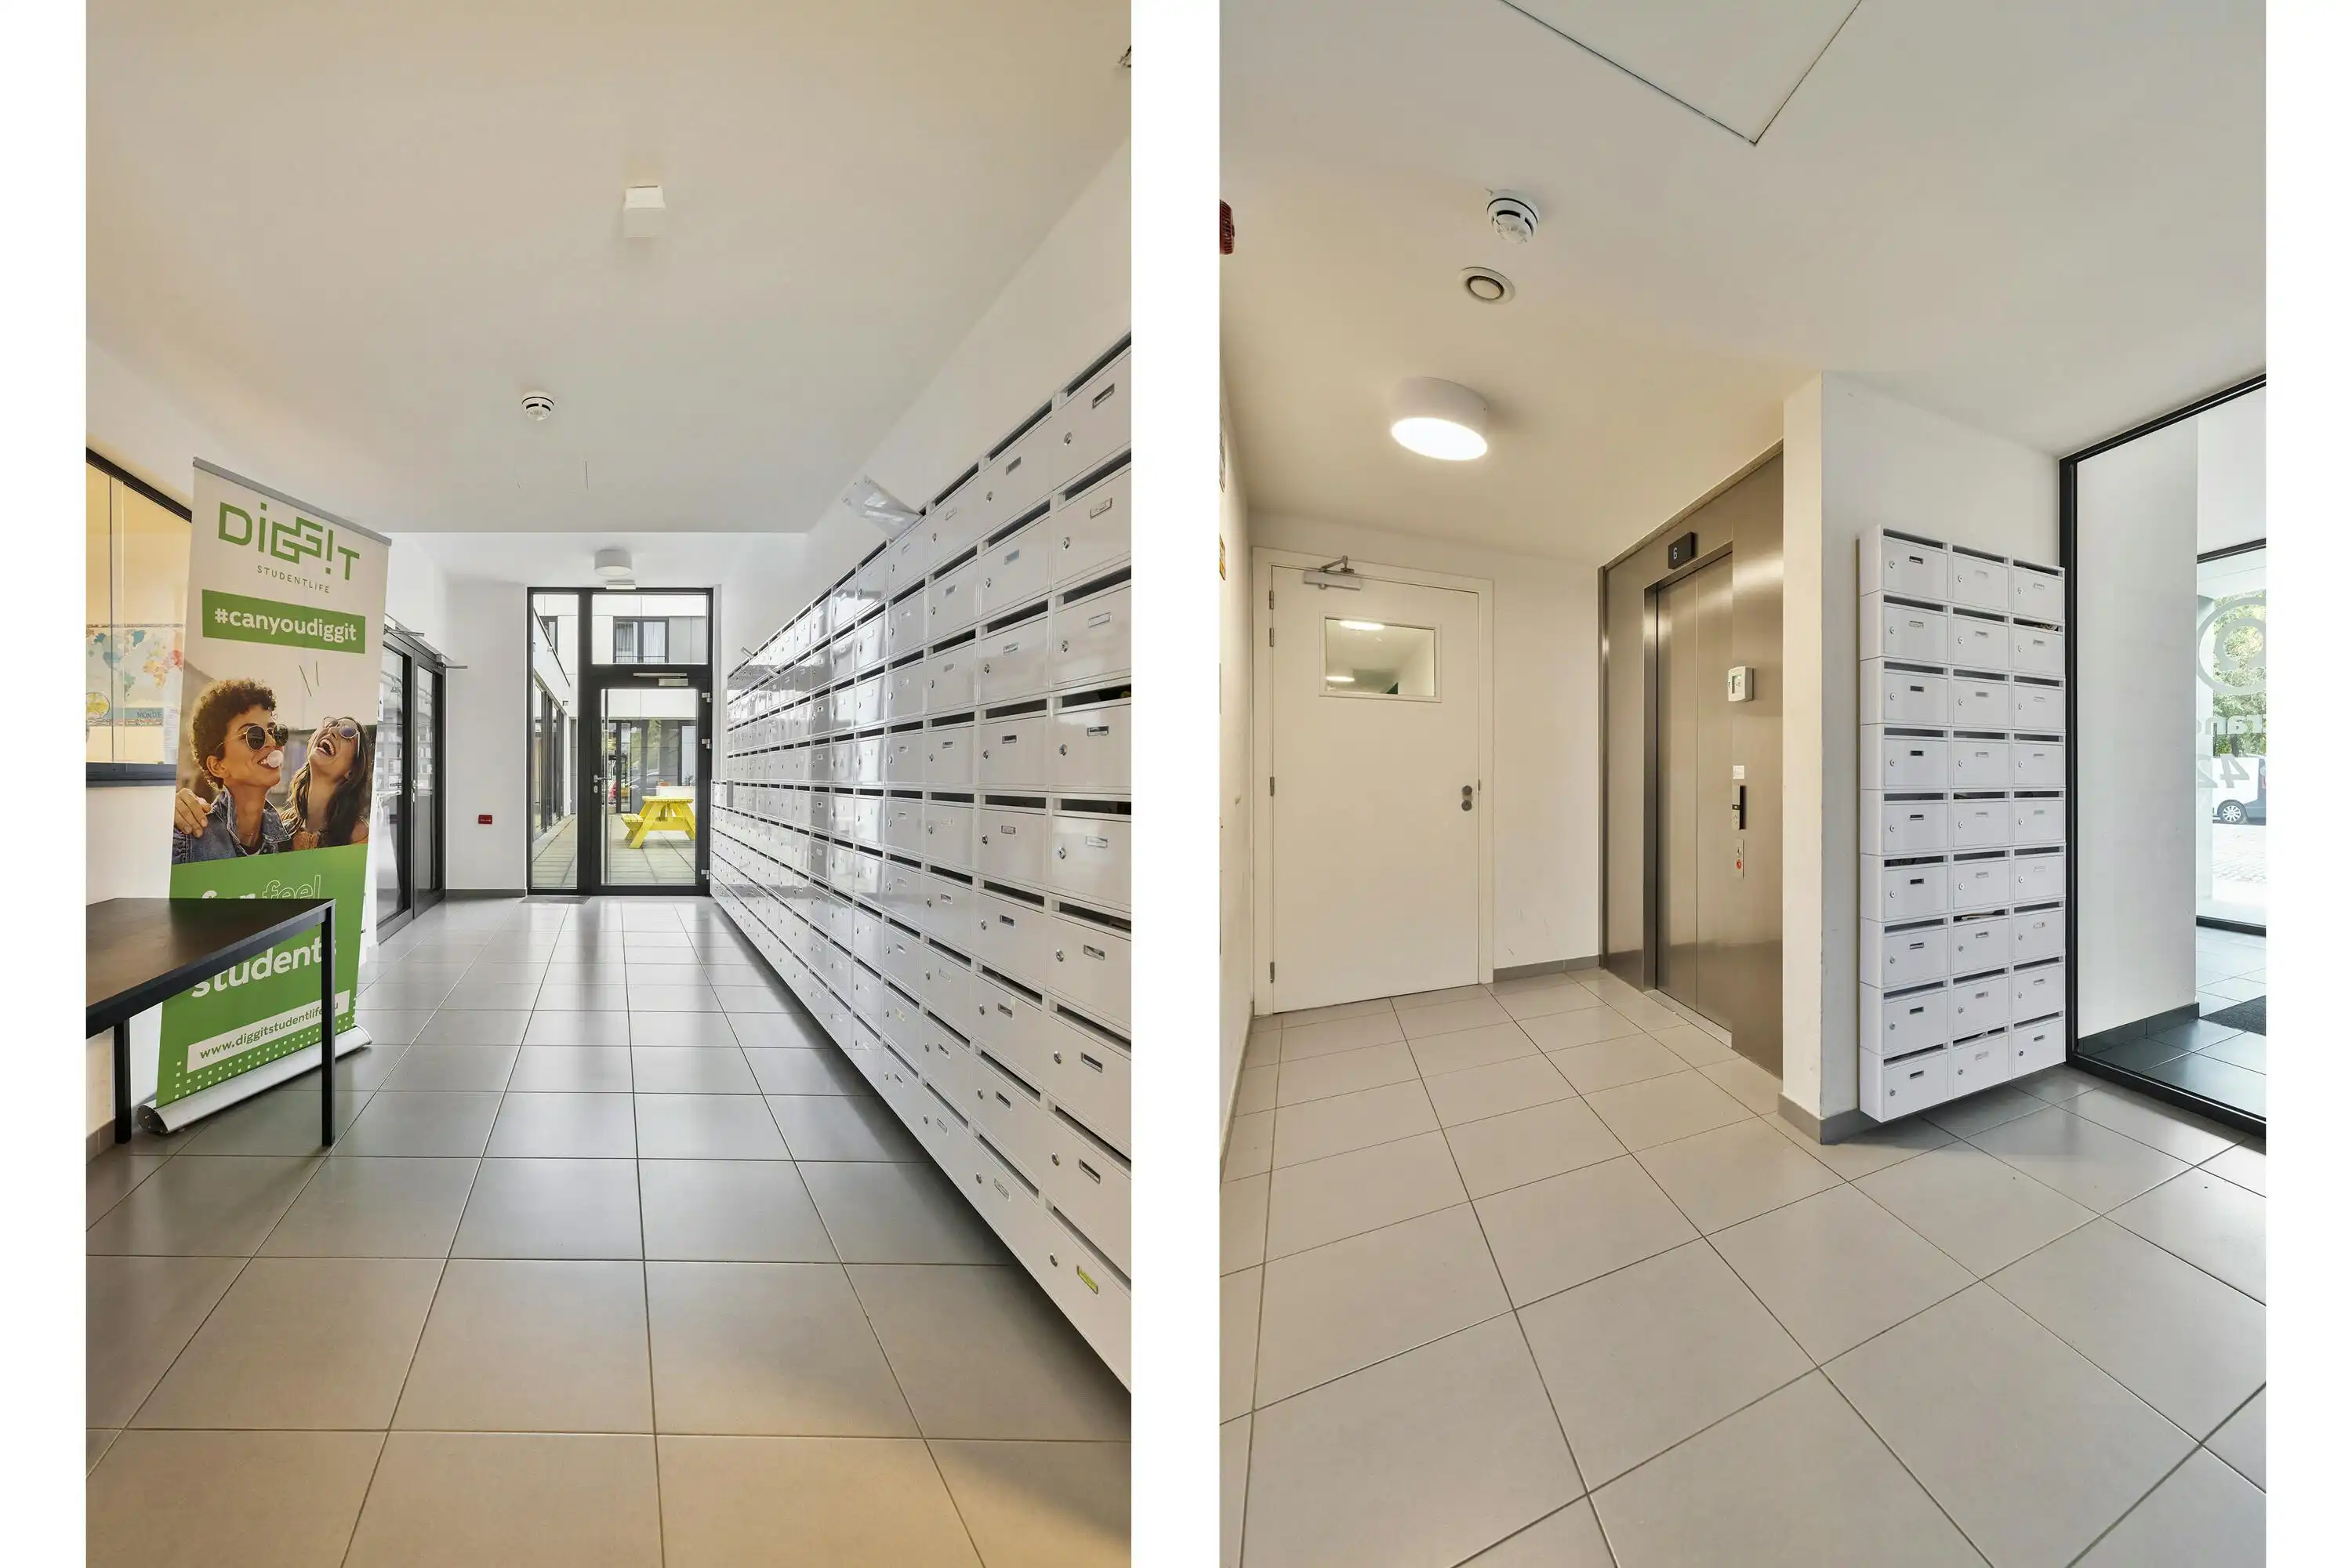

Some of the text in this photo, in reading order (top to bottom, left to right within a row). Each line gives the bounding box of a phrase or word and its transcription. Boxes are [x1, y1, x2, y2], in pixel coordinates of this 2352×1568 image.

[1673, 546, 1678, 560] 6
[257, 565, 329, 593] STUDENTLIFE
[214, 608, 357, 643] #canyoudiggit
[191, 936, 337, 998] student
